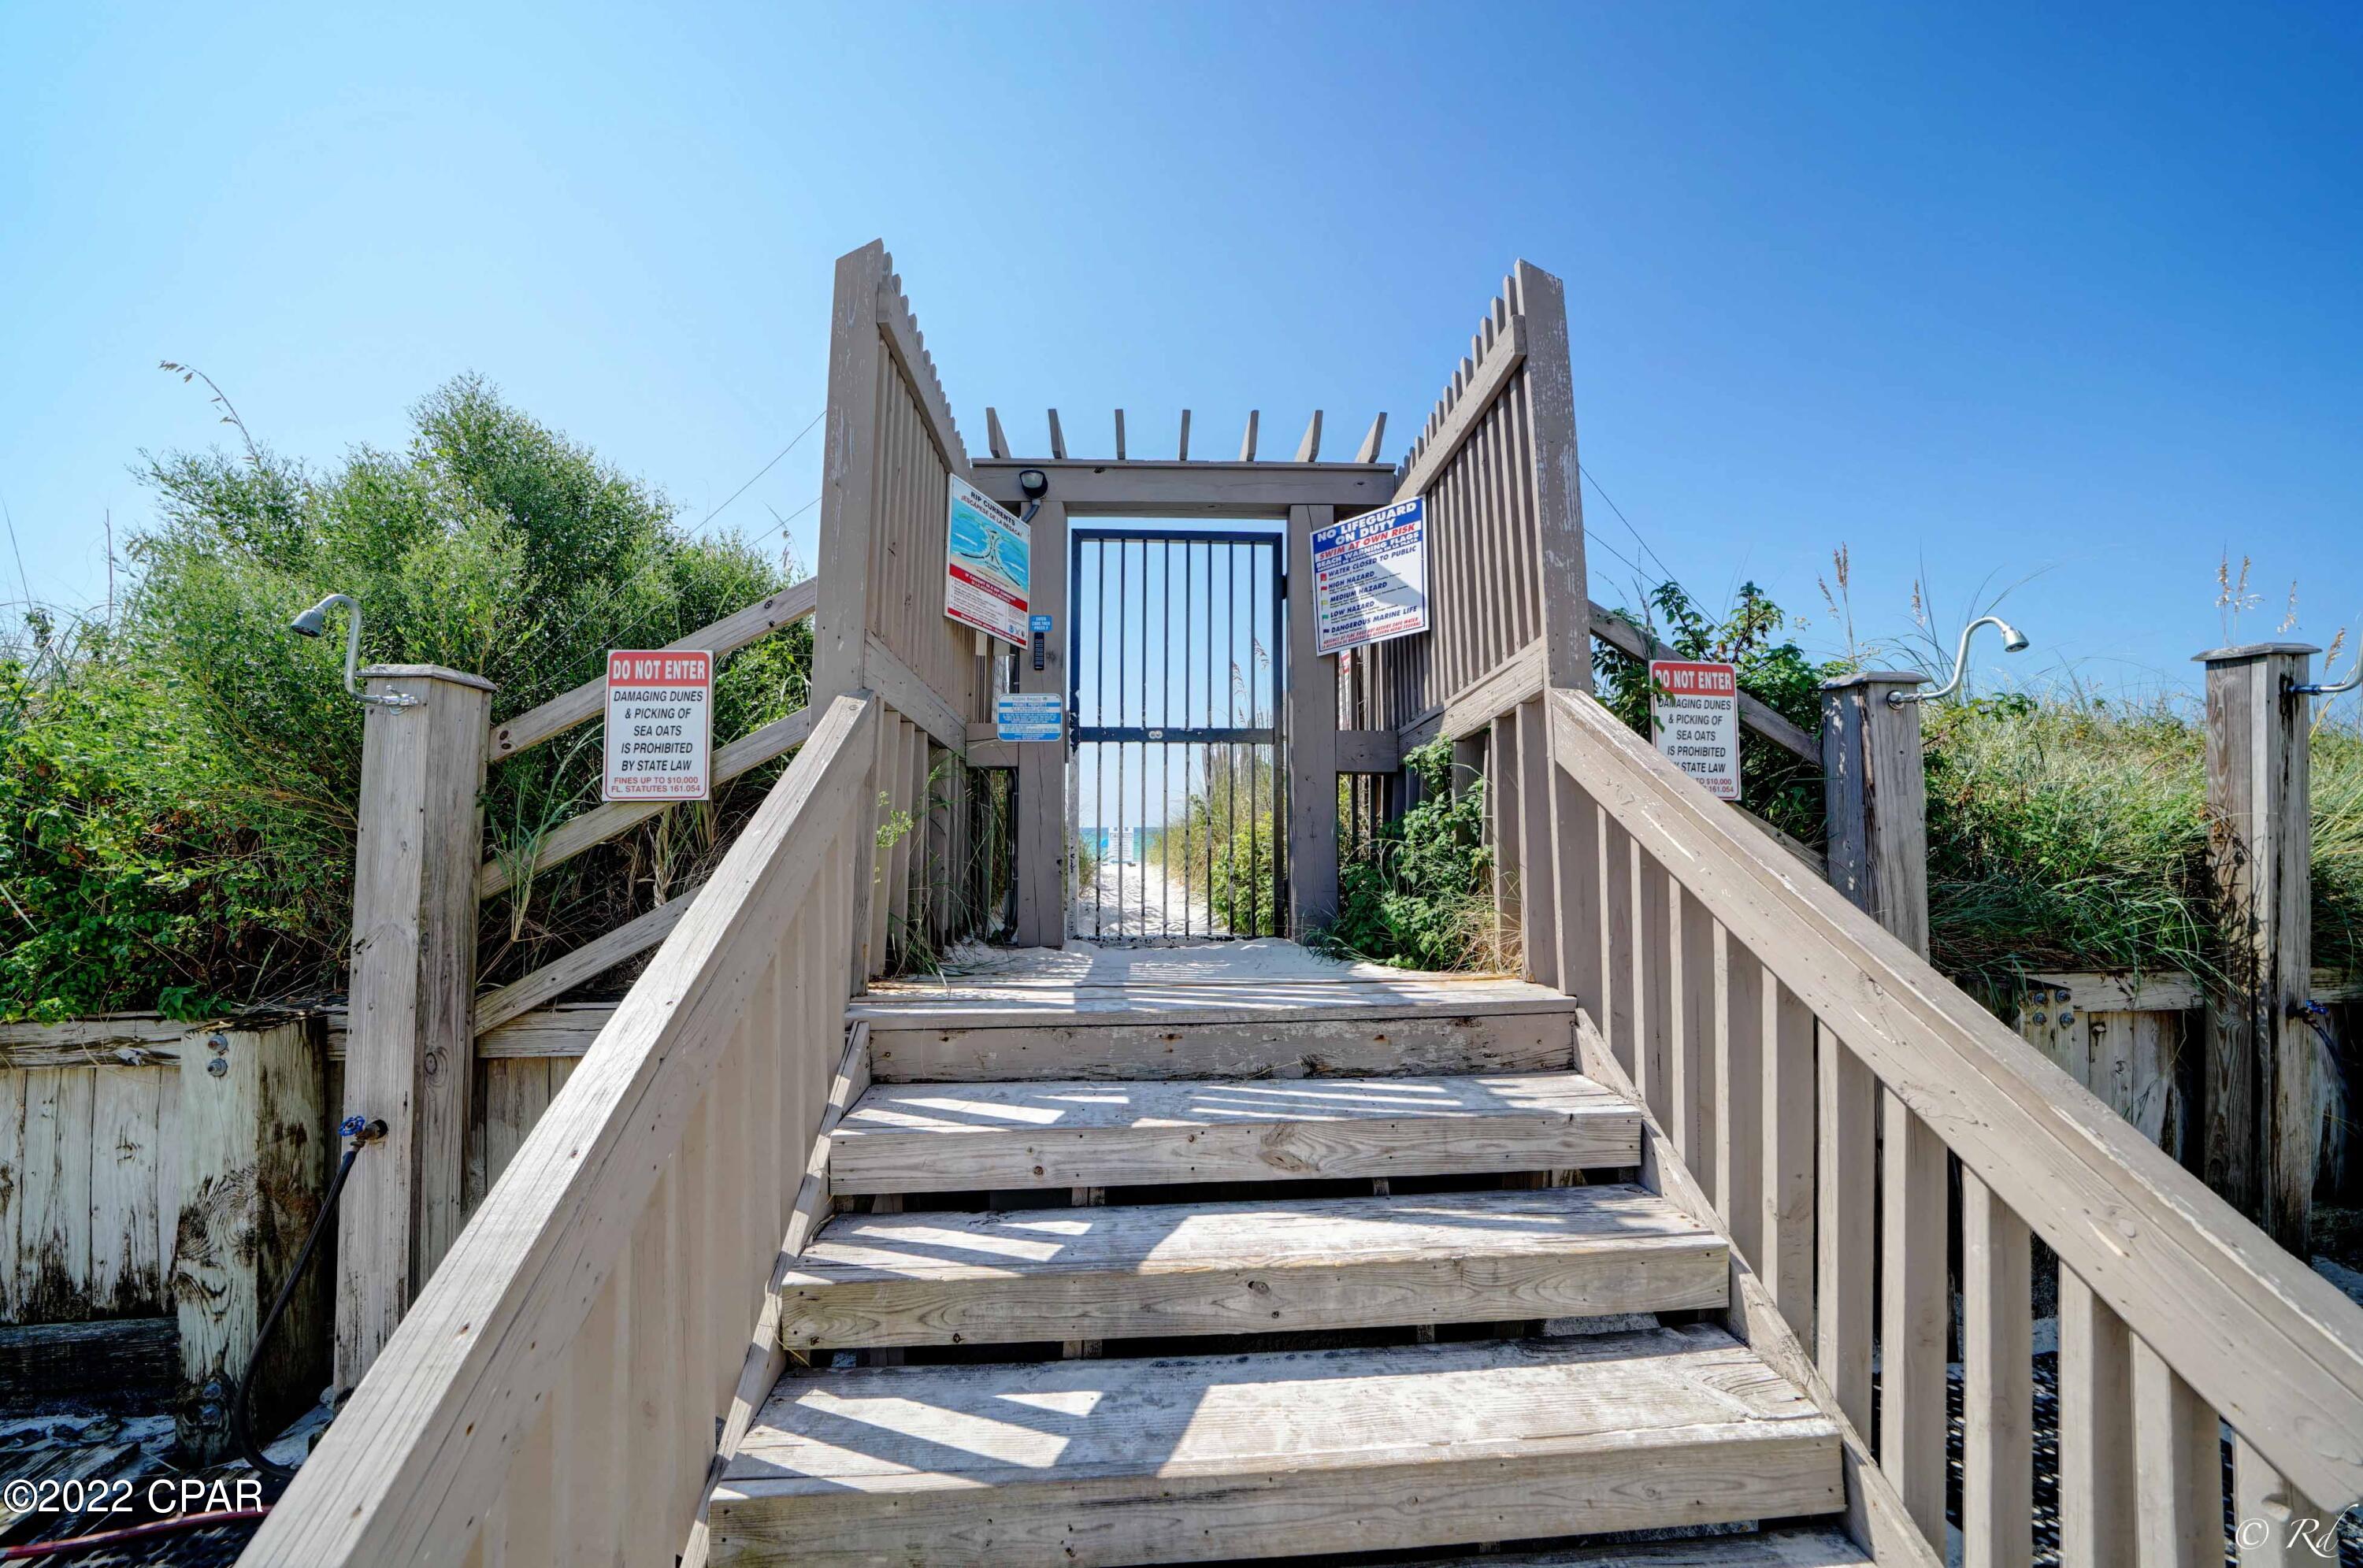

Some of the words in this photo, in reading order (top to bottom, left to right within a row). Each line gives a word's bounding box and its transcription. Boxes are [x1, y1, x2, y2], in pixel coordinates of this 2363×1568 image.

[970, 491, 981, 503] RIP
[983, 499, 1015, 526] CURRENTS
[1317, 529, 1337, 543] NO
[1341, 502, 1416, 533] LIFEGUARD
[1335, 533, 1355, 546] ON
[1360, 518, 1396, 538] DUTY
[1316, 555, 1342, 569] BEACH
[1344, 541, 1387, 558] WARNING
[1390, 532, 1419, 545] FLAGS
[1319, 547, 1345, 560] SWIM
[1348, 542, 1360, 551] AT
[1363, 532, 1388, 546] OWN
[1392, 524, 1415, 537] RISK
[1328, 565, 1350, 576] WATER
[1352, 558, 1378, 569] CLOSED
[1391, 545, 1417, 558] PUBLIC
[1328, 580, 1345, 589] HIGH
[1347, 571, 1374, 584] HAZARD
[1330, 590, 1356, 602] MEDIUM
[1359, 582, 1388, 593] HAZARD
[1330, 609, 1345, 617] LOW
[1347, 601, 1374, 614] HAZARD
[1331, 617, 1371, 633] DANGEROUS
[1373, 610, 1400, 622] MARINE
[1403, 606, 1418, 615] LIFE
[613, 660, 629, 680] DO
[635, 660, 661, 680] NOT
[665, 660, 706, 680] ENTER
[1674, 670, 1695, 688] NOT
[1698, 672, 1731, 690] ENTER
[614, 691, 667, 702] DAMAGING
[670, 691, 703, 702] DUNES
[1705, 700, 1731, 710] DUNES
[625, 709, 632, 719] &
[634, 708, 675, 719] PICKING
[677, 708, 692, 719] OF
[1668, 714, 1674, 724] &
[1676, 714, 1709, 725] PICKING
[1712, 716, 1723, 725] OF
[633, 725, 652, 736] SEA
[655, 725, 681, 736] OATS
[1676, 730, 1692, 740] SEA
[1694, 731, 1716, 741] OATS
[621, 743, 631, 754] IS
[633, 743, 693, 754] PROHIBITED
[1667, 746, 1675, 755] IS
[1677, 746, 1726, 758] PROHIBITED
[621, 760, 635, 771] BY
[637, 760, 667, 771] STATE
[670, 760, 692, 771] LAW
[1682, 762, 1705, 773] STATE
[1708, 762, 1726, 773] LAW
